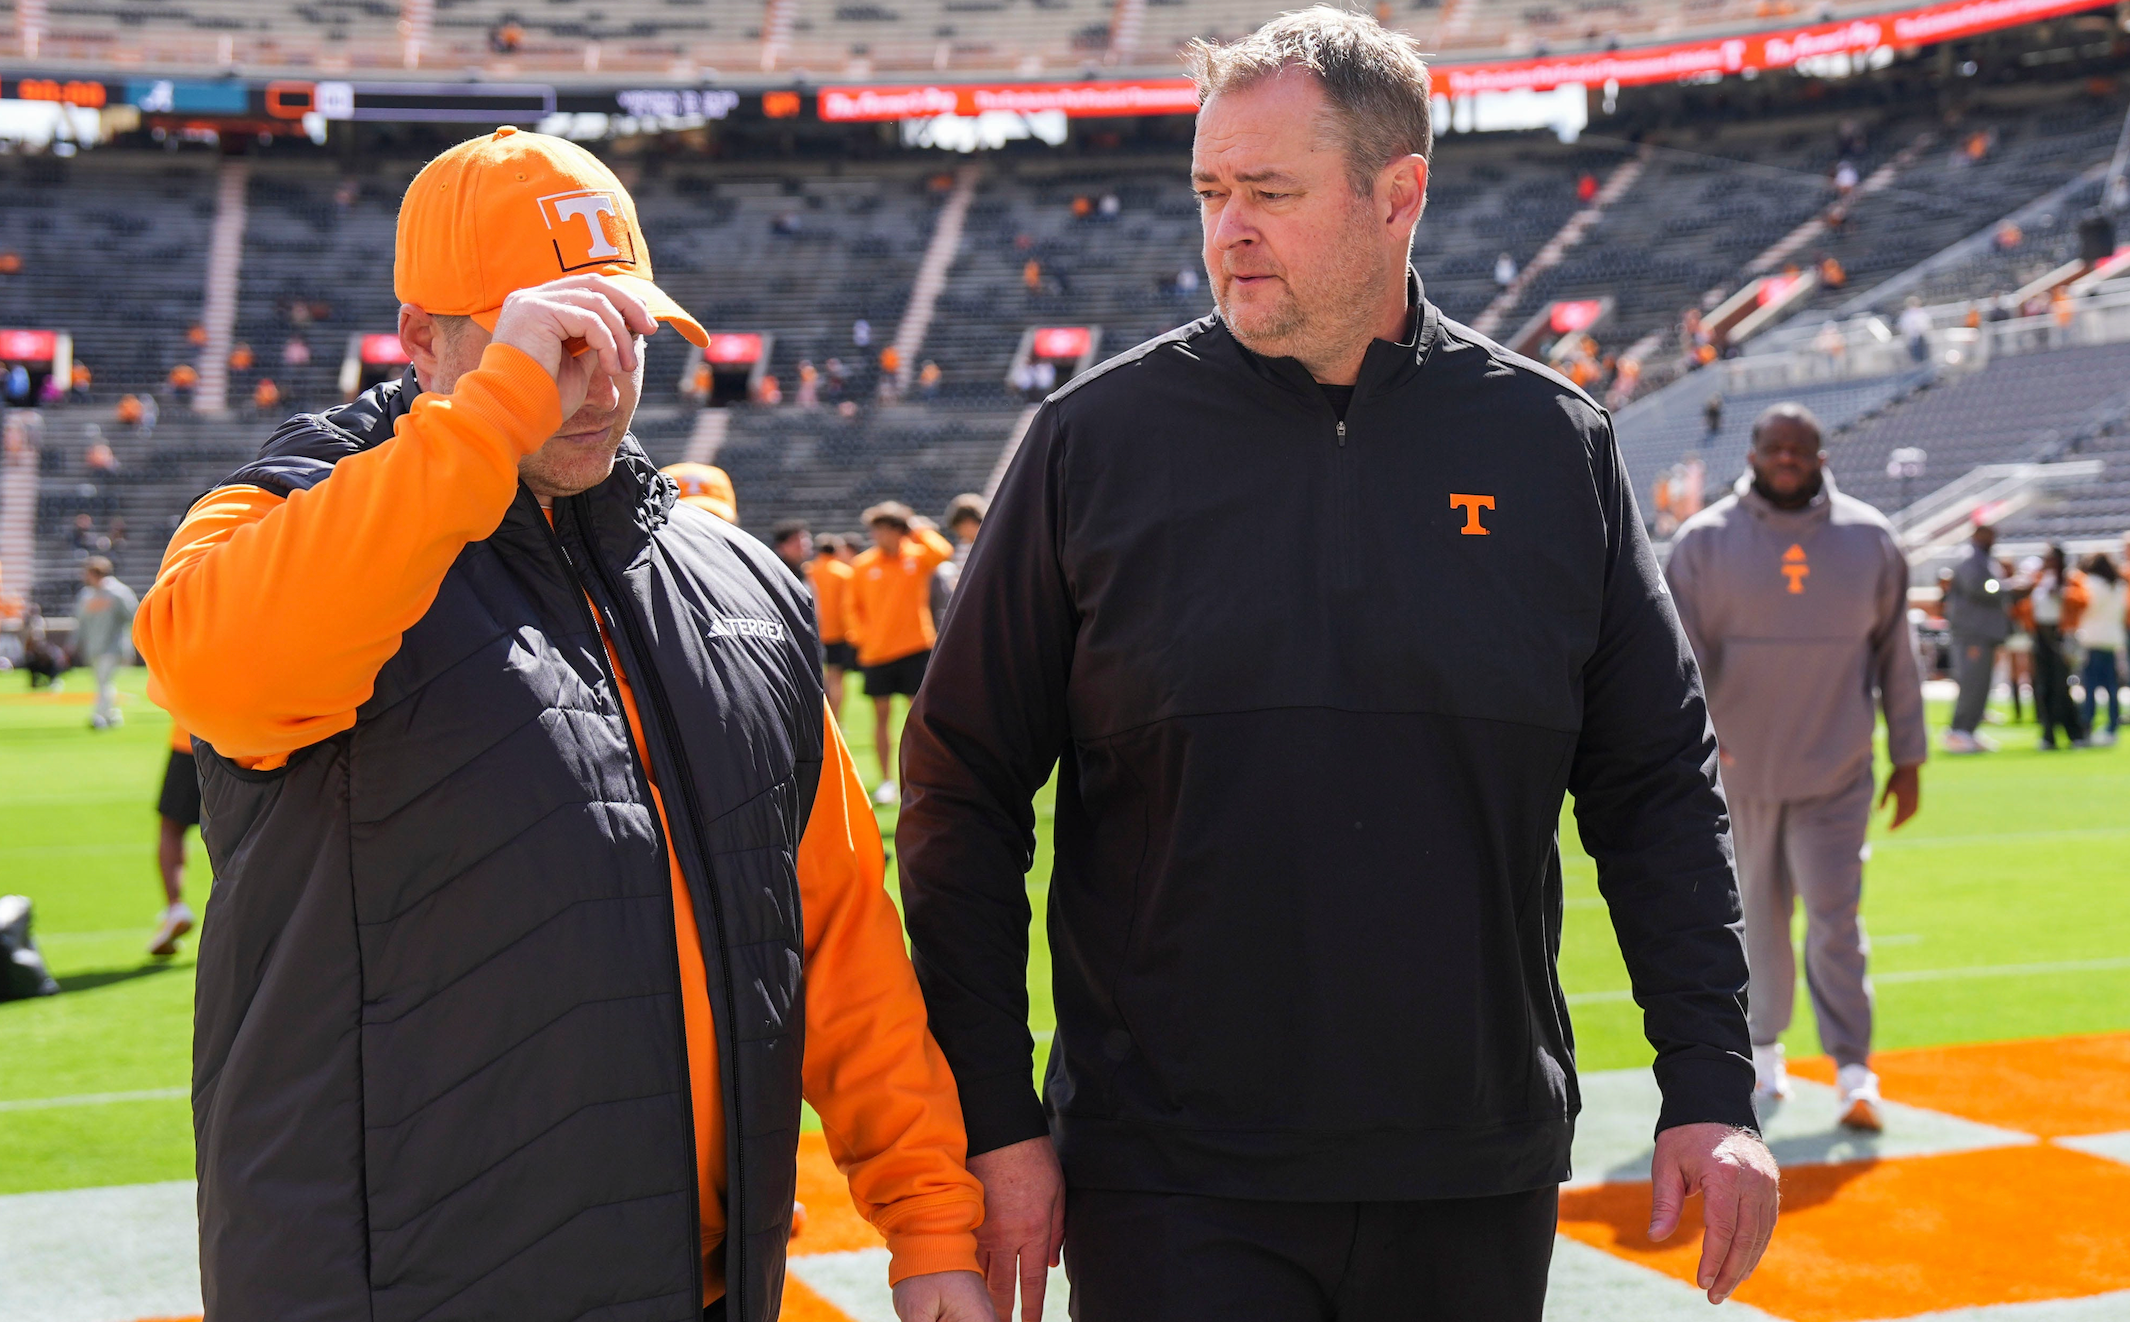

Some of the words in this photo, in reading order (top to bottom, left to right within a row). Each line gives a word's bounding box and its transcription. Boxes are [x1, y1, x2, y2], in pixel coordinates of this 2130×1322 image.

[554, 195, 619, 258] T
[1450, 493, 1495, 535] T
[724, 618, 785, 641] TERREX
